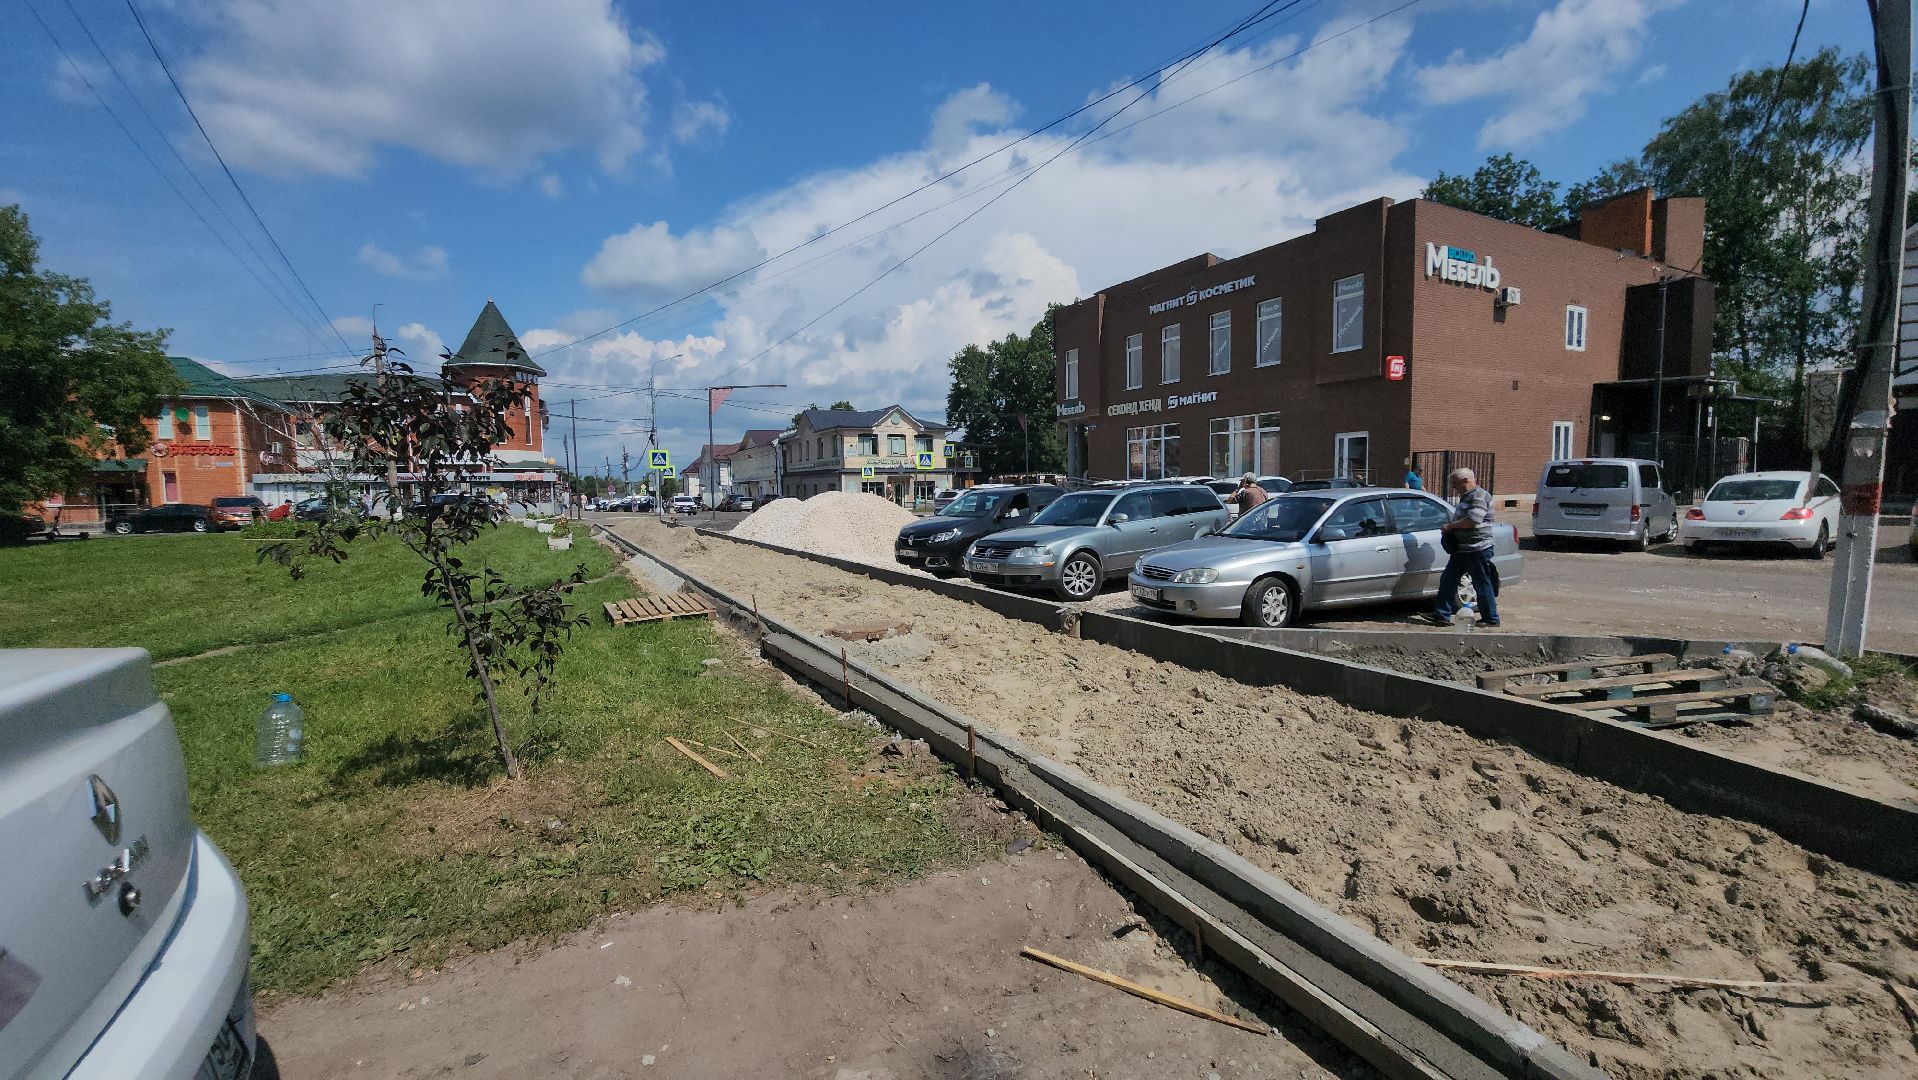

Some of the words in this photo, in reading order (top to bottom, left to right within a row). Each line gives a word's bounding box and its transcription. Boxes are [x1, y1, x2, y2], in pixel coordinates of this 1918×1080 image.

[1149, 296, 1185, 315] МАГНИТ
[1199, 275, 1256, 300] КОСМЕТИК
[1108, 402, 1138, 416] СЕКОНД
[1139, 399, 1162, 412] ХЕНД
[1179, 391, 1218, 406] МАГНИТ
